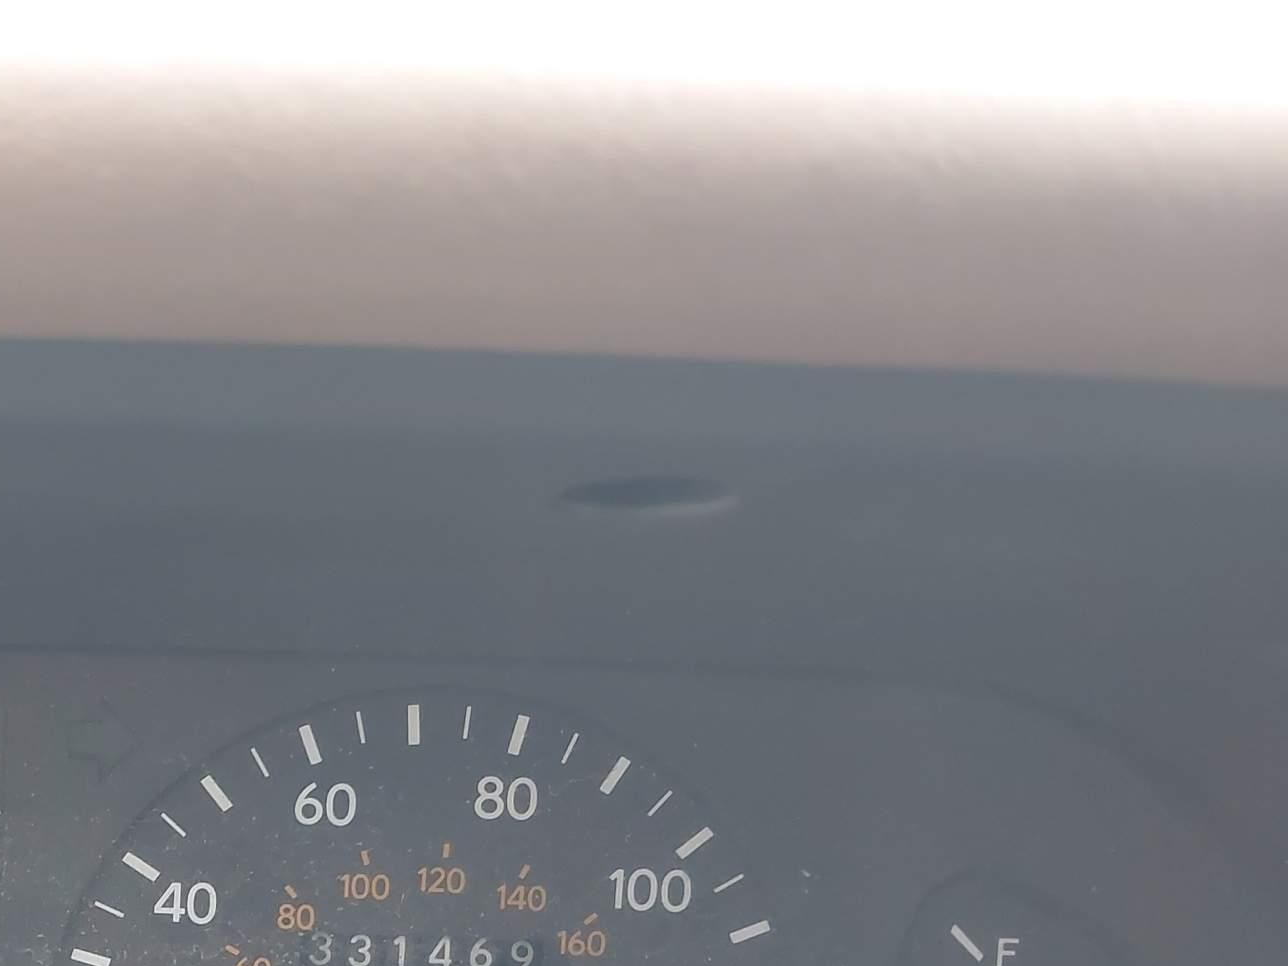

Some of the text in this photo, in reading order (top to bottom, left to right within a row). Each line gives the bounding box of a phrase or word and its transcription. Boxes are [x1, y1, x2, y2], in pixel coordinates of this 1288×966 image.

[295, 782, 358, 827] 60
[474, 776, 538, 821] 80
[340, 874, 391, 900] 100
[417, 867, 466, 894] 120
[609, 868, 692, 912] 100
[153, 881, 218, 925] 40
[497, 883, 547, 912] 140
[277, 903, 316, 930] 80
[557, 930, 607, 957] 160
